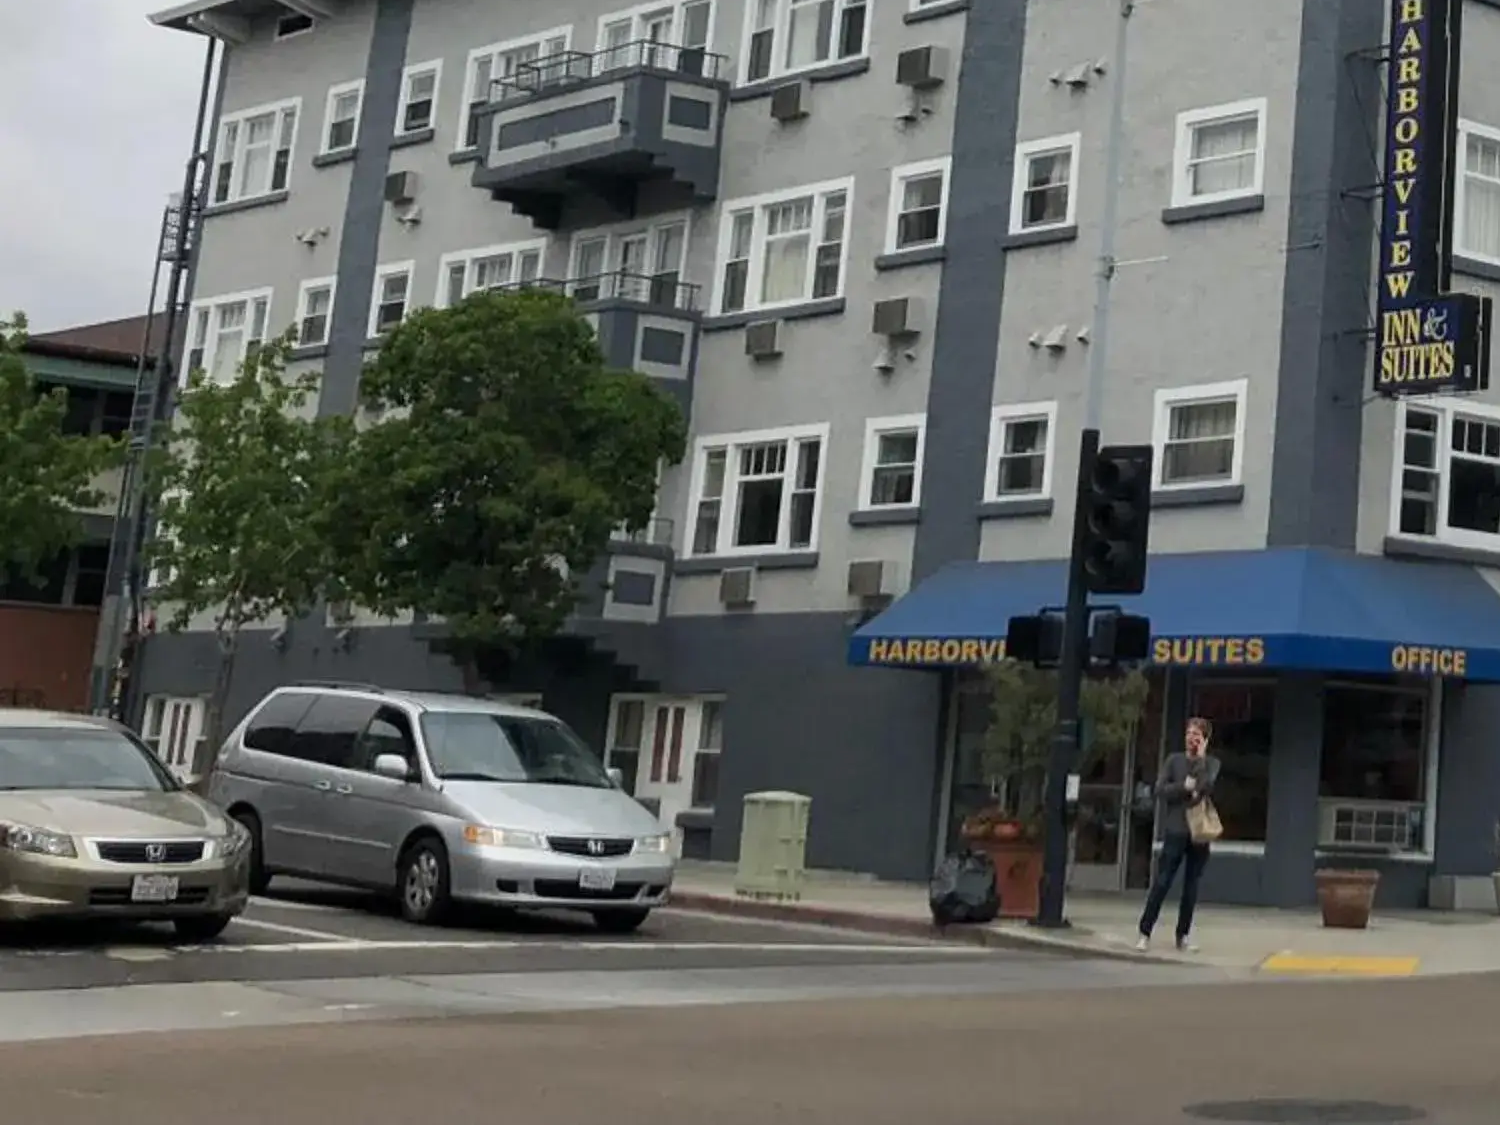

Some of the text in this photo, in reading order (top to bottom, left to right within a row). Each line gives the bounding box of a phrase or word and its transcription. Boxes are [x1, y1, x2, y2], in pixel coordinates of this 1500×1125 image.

[1382, 307, 1447, 346] INN &
[1380, 340, 1455, 383] SUITES
[869, 638, 1265, 664] HARBORVI SUITES
[1391, 645, 1467, 675] OFFICE
